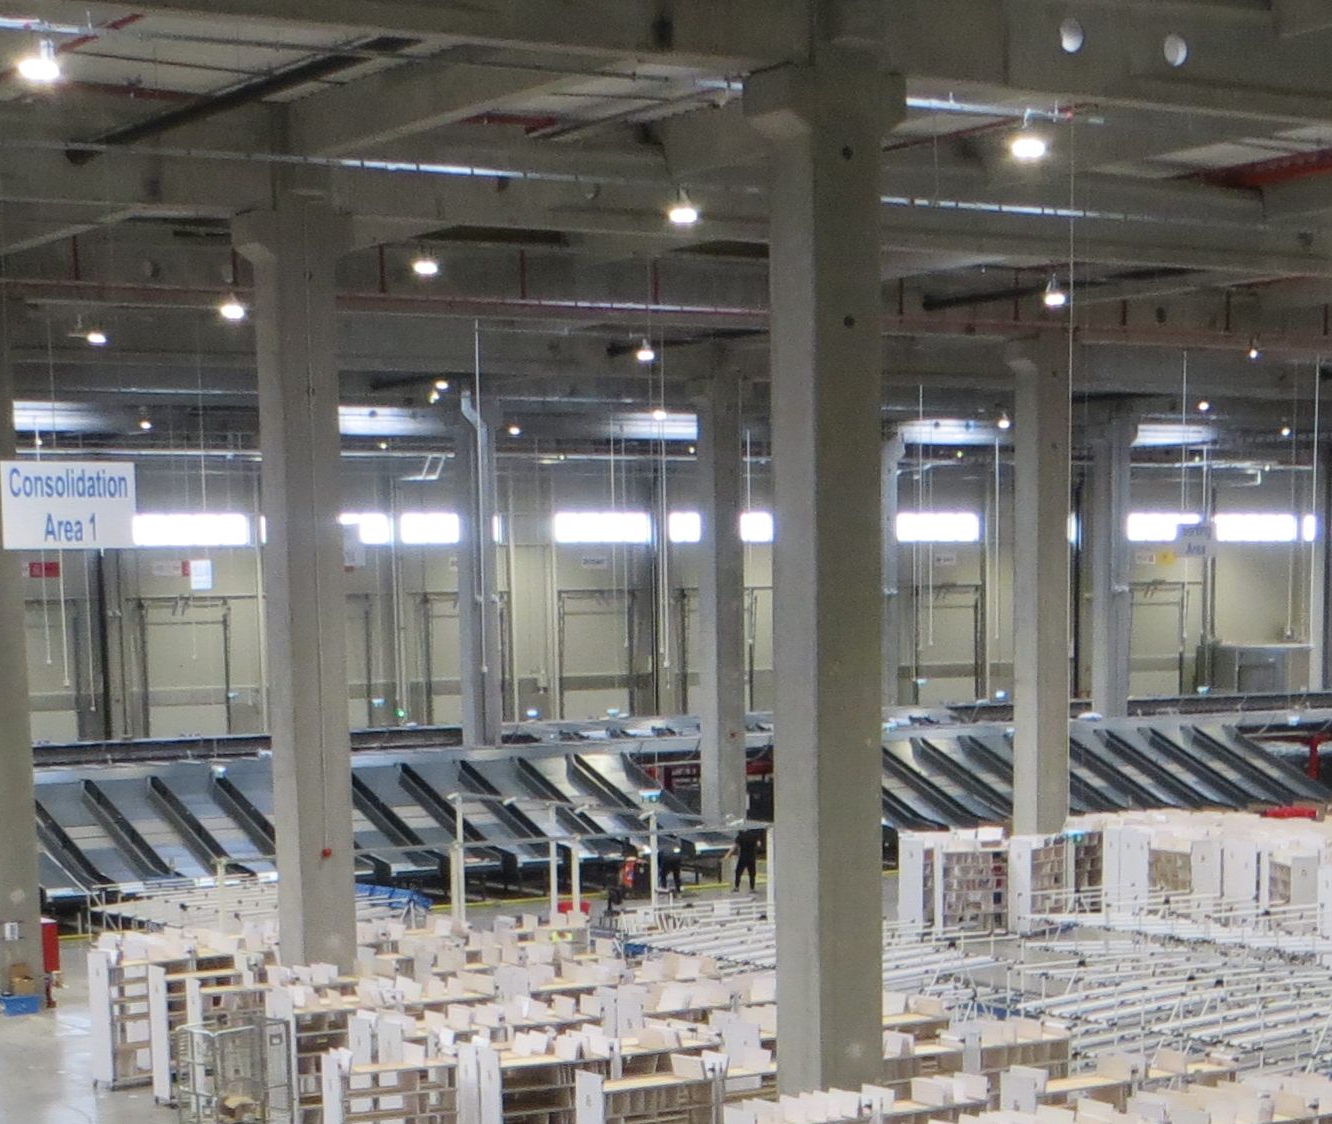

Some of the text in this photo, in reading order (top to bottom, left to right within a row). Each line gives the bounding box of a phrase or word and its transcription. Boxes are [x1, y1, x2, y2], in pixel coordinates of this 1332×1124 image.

[9, 467, 128, 498] Consolidation
[44, 512, 96, 541] Area 1
